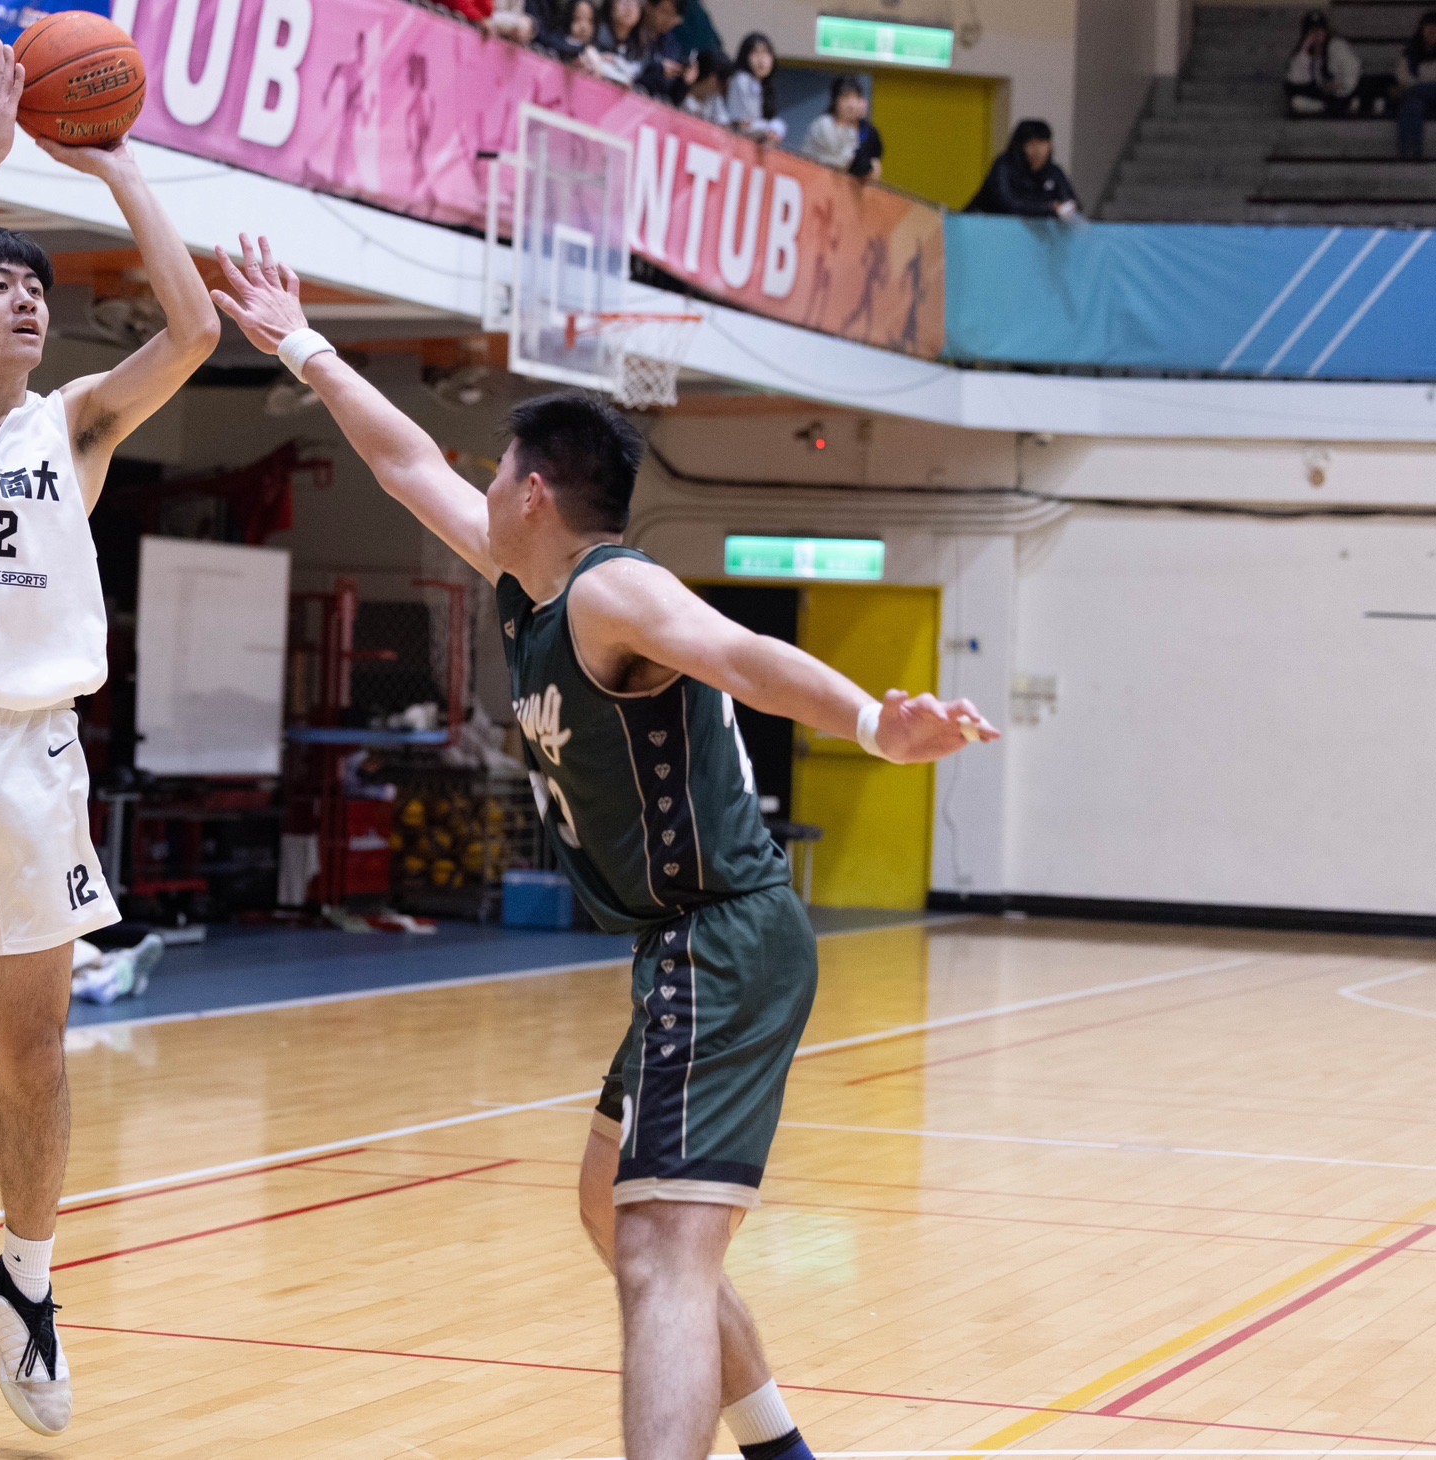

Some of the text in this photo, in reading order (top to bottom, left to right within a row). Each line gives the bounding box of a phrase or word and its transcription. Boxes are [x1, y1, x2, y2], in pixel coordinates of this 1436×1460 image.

[66, 67, 137, 103] LEGACY
[110, 0, 313, 147] UB
[630, 126, 803, 298] NTUB
[1, 573, 45, 586] SPORTS
[67, 864, 99, 911] 12
